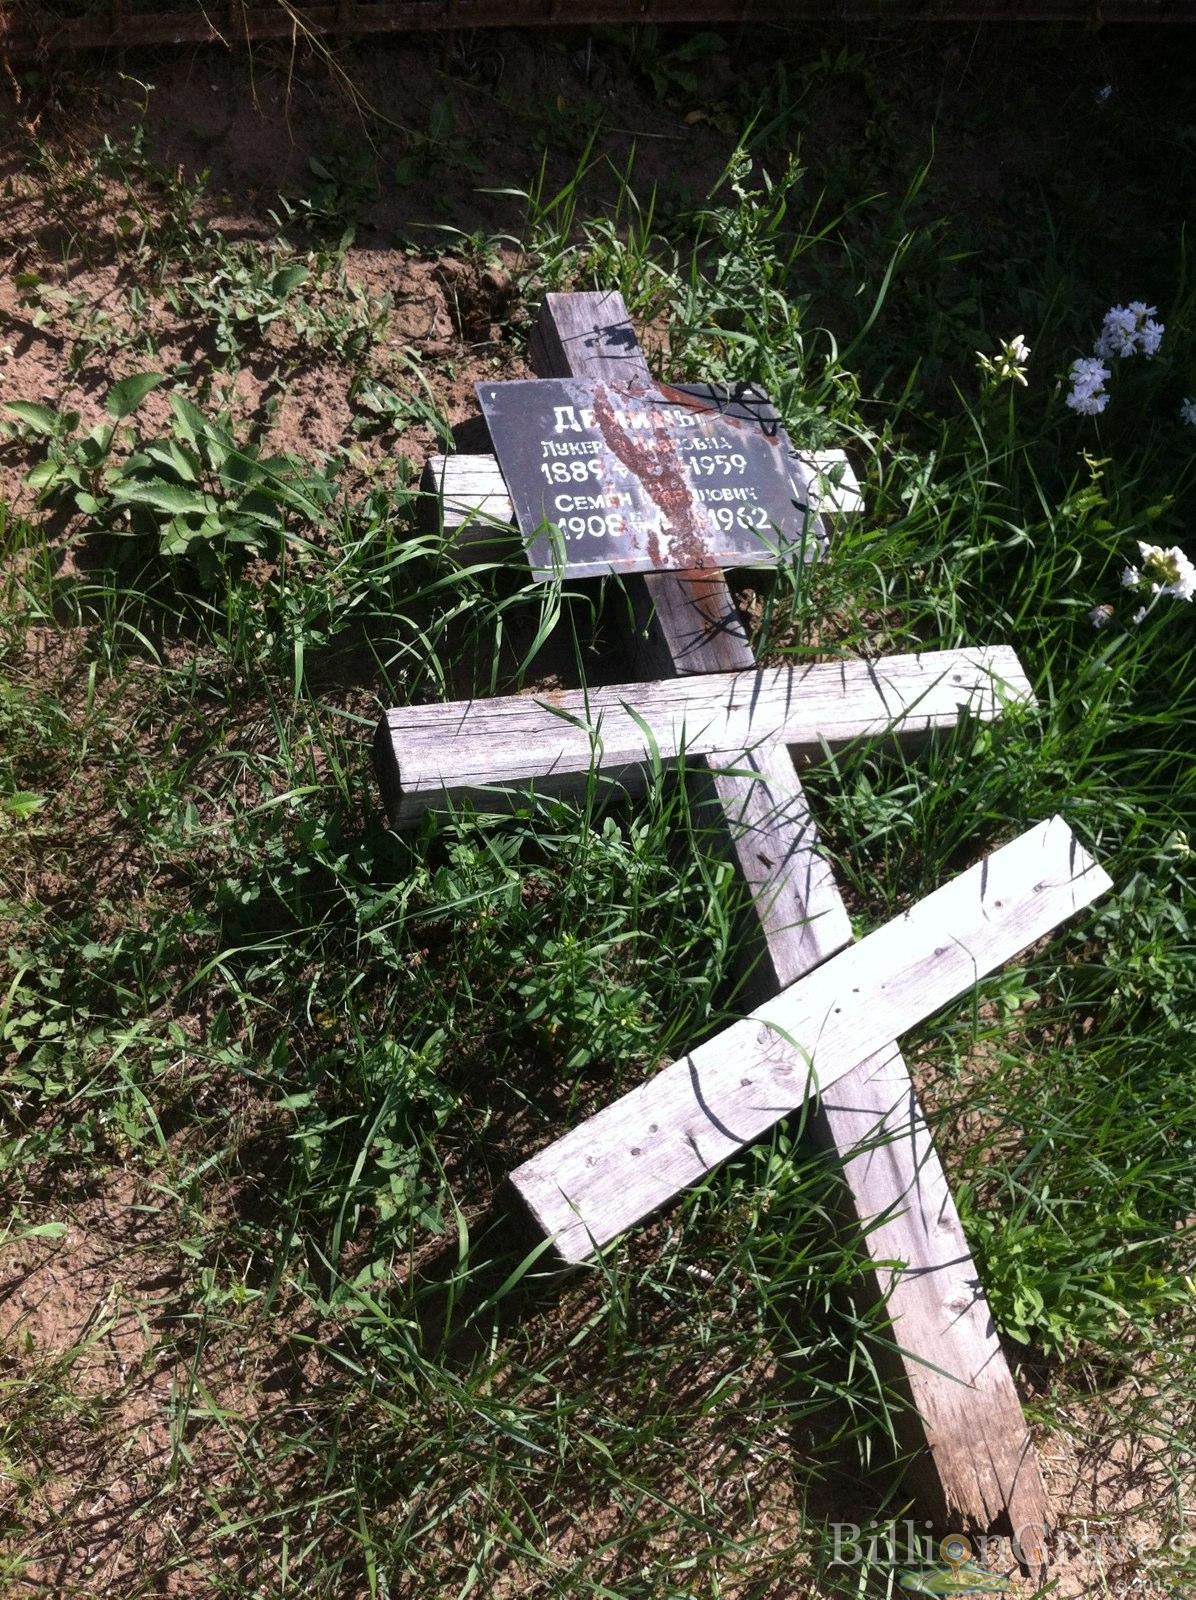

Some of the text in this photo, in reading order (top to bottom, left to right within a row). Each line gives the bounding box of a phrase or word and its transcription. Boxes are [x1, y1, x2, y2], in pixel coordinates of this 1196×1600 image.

[541, 459, 603, 485] 1889
[557, 507, 771, 541] 1908 1962
